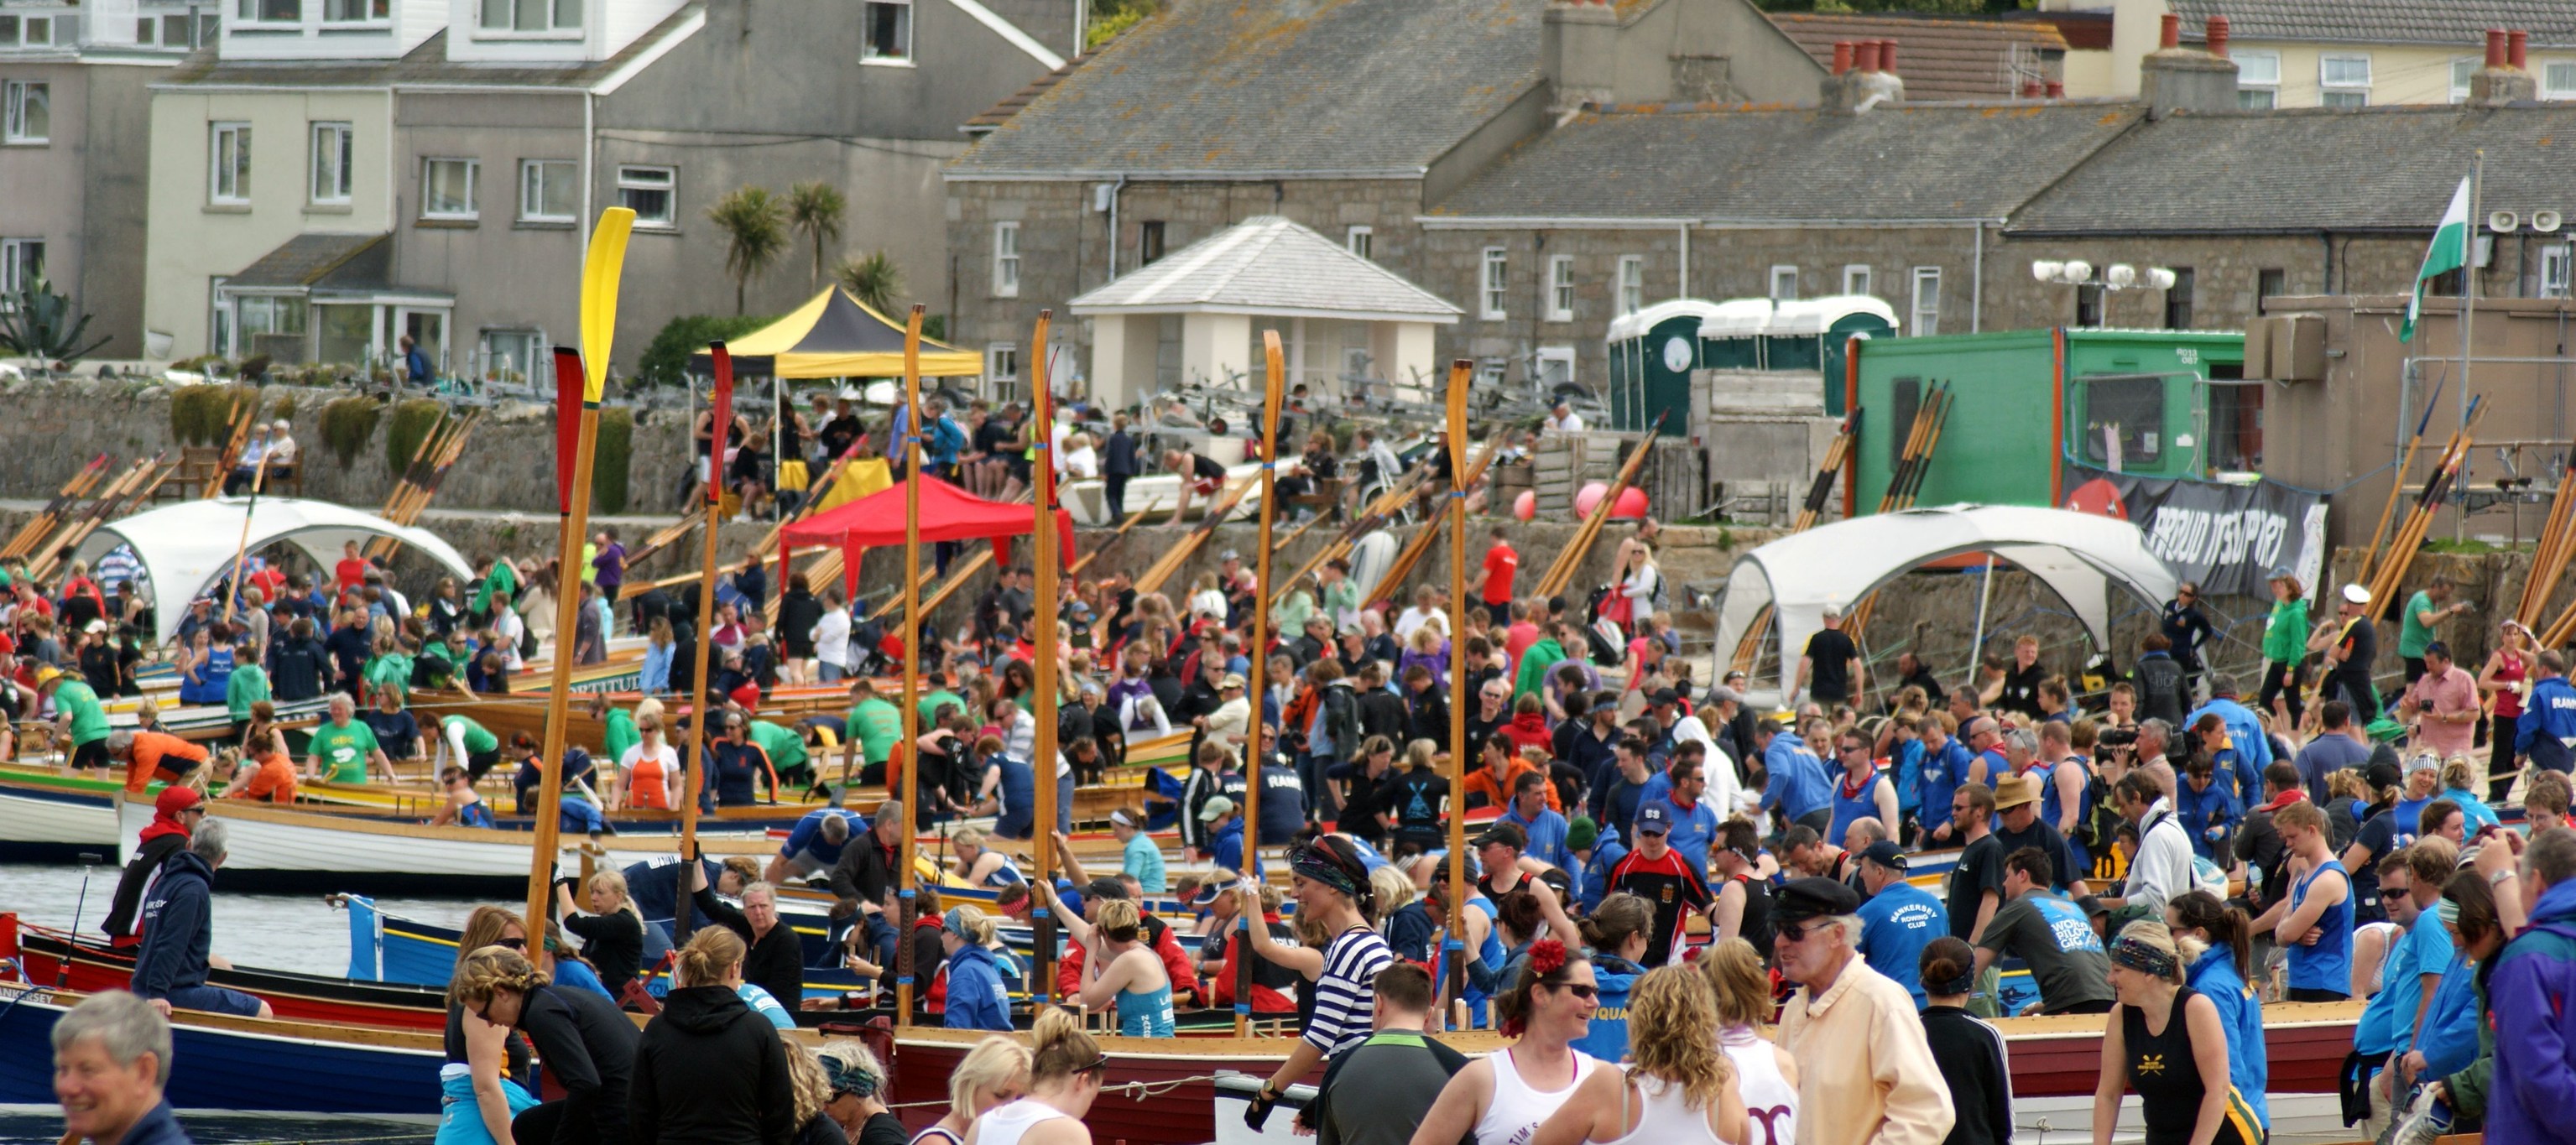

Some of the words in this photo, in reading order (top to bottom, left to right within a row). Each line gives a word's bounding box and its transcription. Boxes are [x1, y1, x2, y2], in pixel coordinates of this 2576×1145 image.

[2150, 507, 2210, 564] PROUD
[1890, 903, 1937, 924] NANKERSEY
[1901, 913, 1929, 924] ROWING
[1907, 920, 1927, 929] CLUB
[2056, 928, 2086, 940] PILOT
[2061, 936, 2083, 948] GIG
